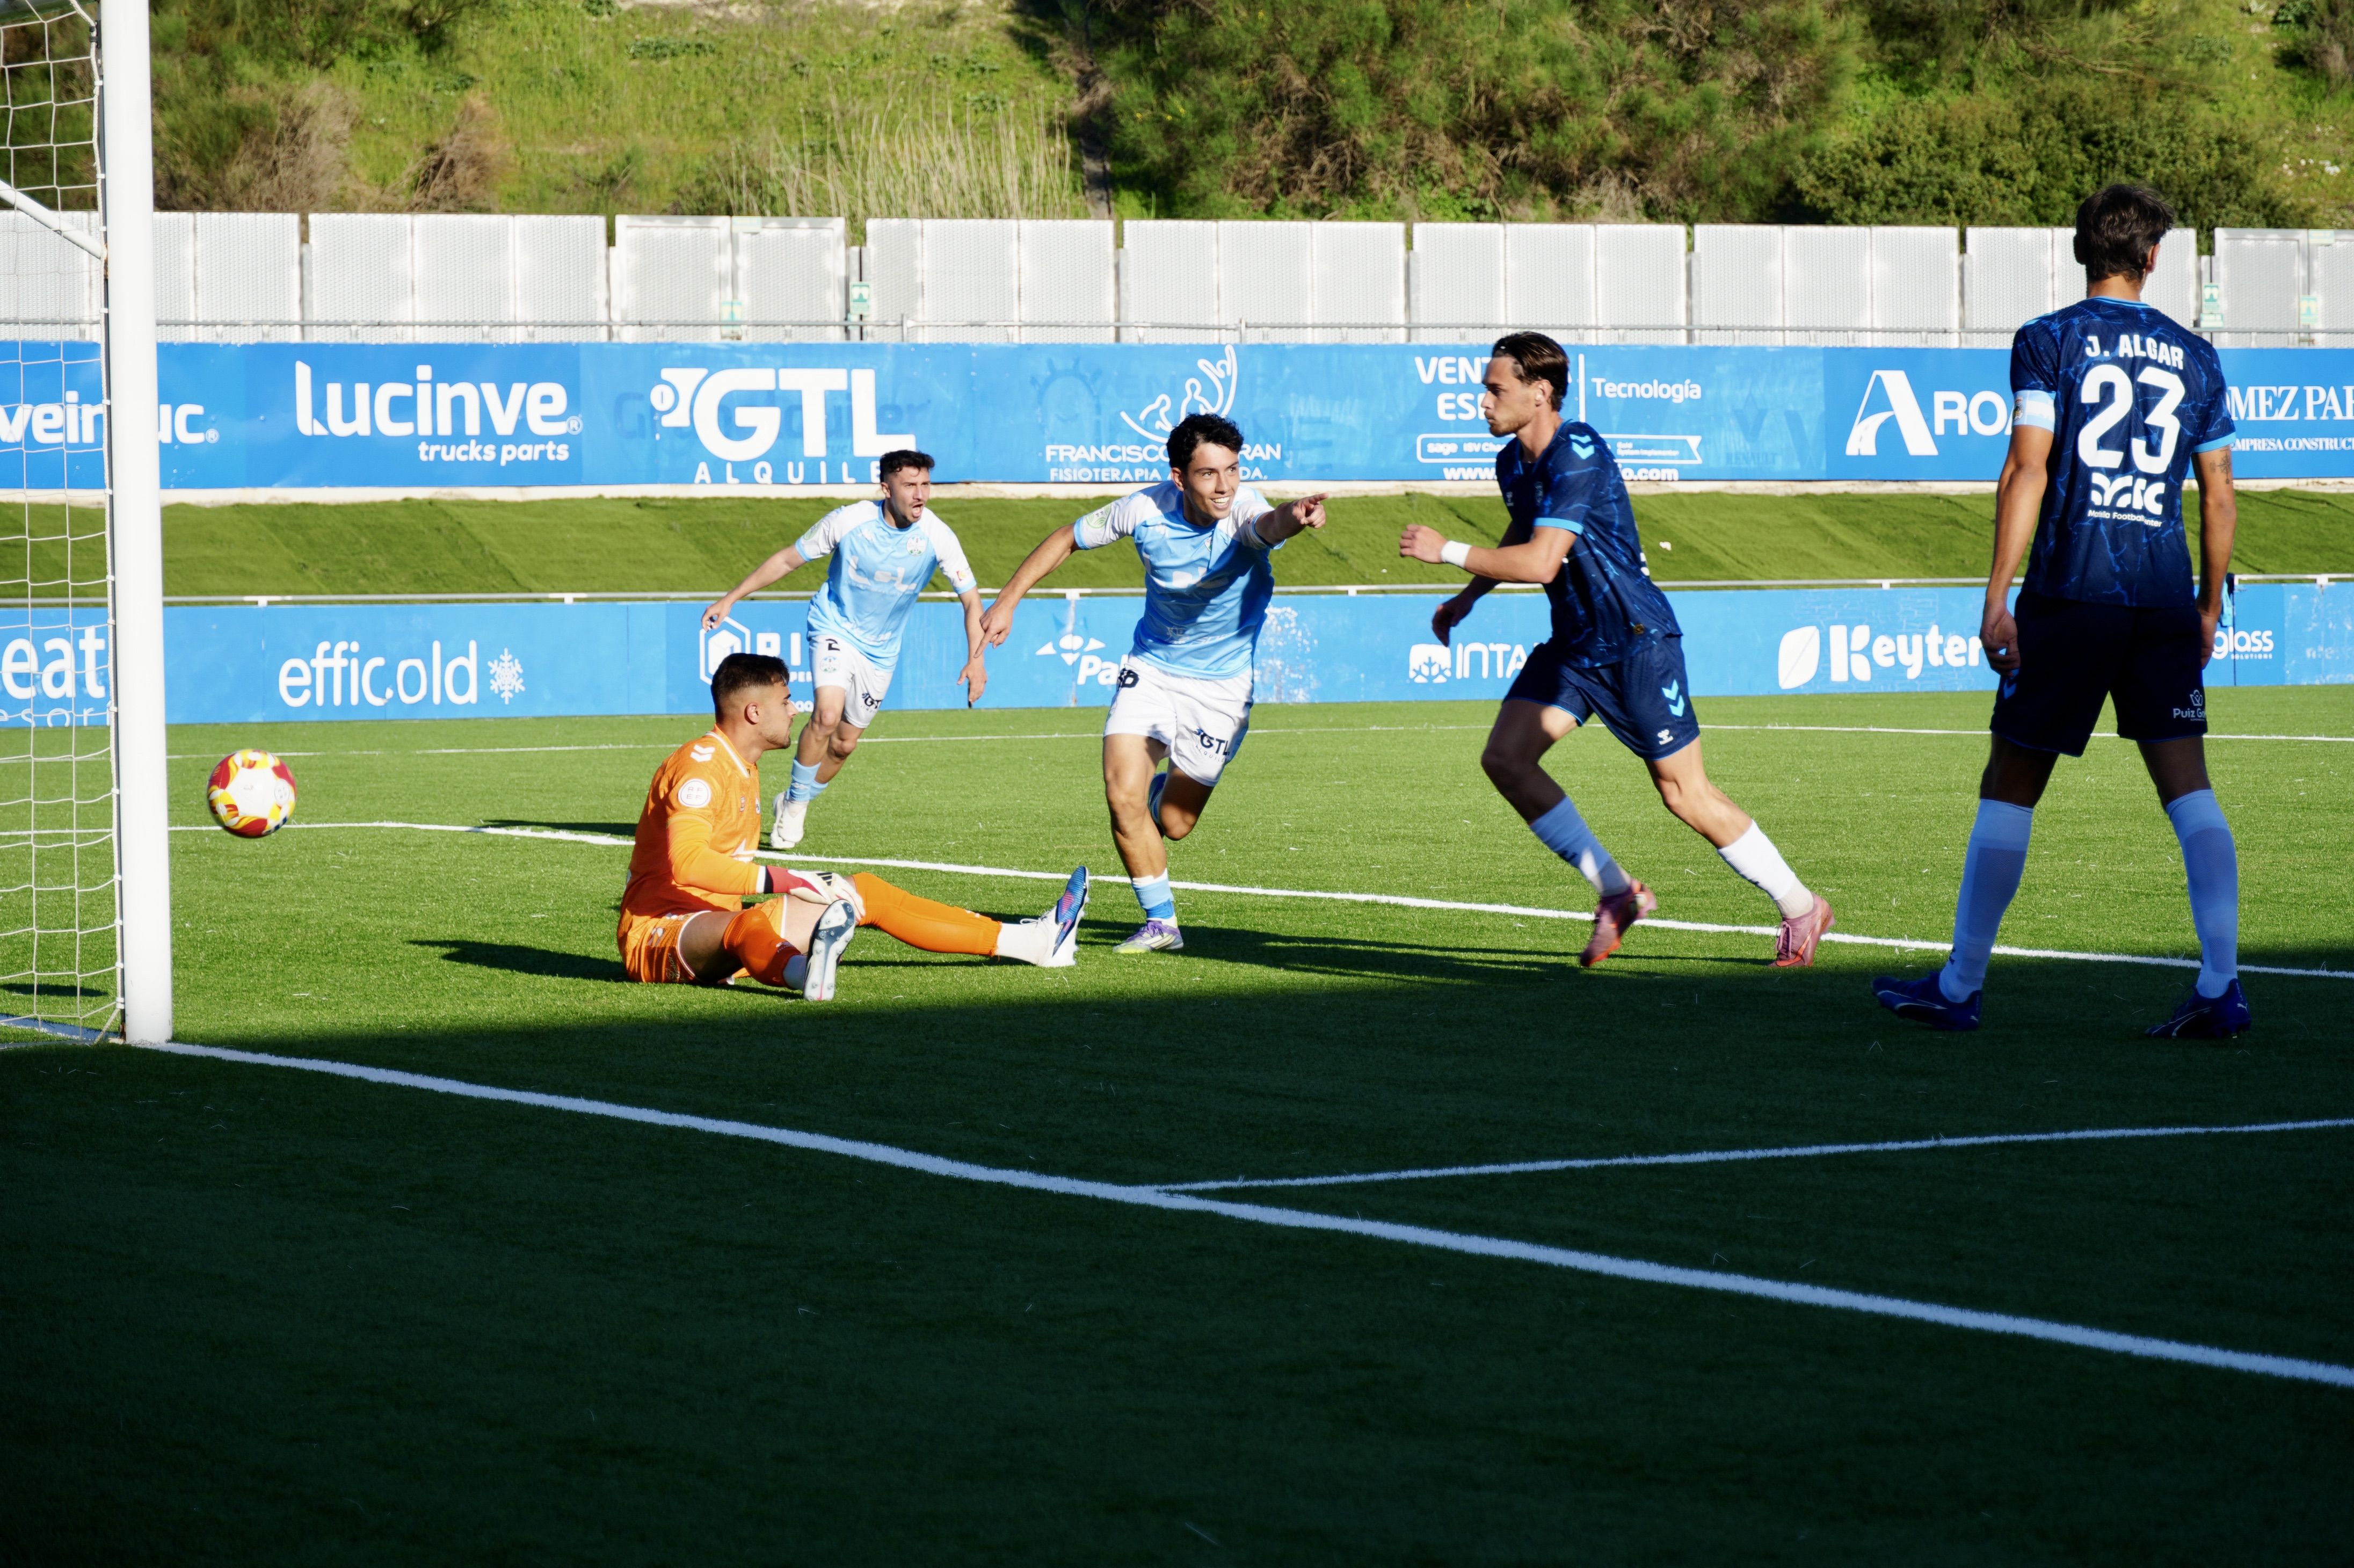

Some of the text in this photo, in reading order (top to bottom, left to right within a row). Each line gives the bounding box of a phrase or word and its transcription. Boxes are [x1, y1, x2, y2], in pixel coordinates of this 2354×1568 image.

[2086, 334, 2184, 370] J. ALGAR
[1591, 378, 1702, 403] Tecnología
[2226, 386, 2299, 420] MEZ
[693, 368, 916, 461] GTL
[2078, 364, 2185, 474] 23
[418, 439, 570, 466] trucks parts
[1238, 442, 1282, 461] RAN
[694, 461, 882, 484] ALQUILE
[1050, 467, 1163, 482] FISIOTERAPIA
[279, 640, 477, 707] efficold
[1456, 642, 1541, 679] INTA
